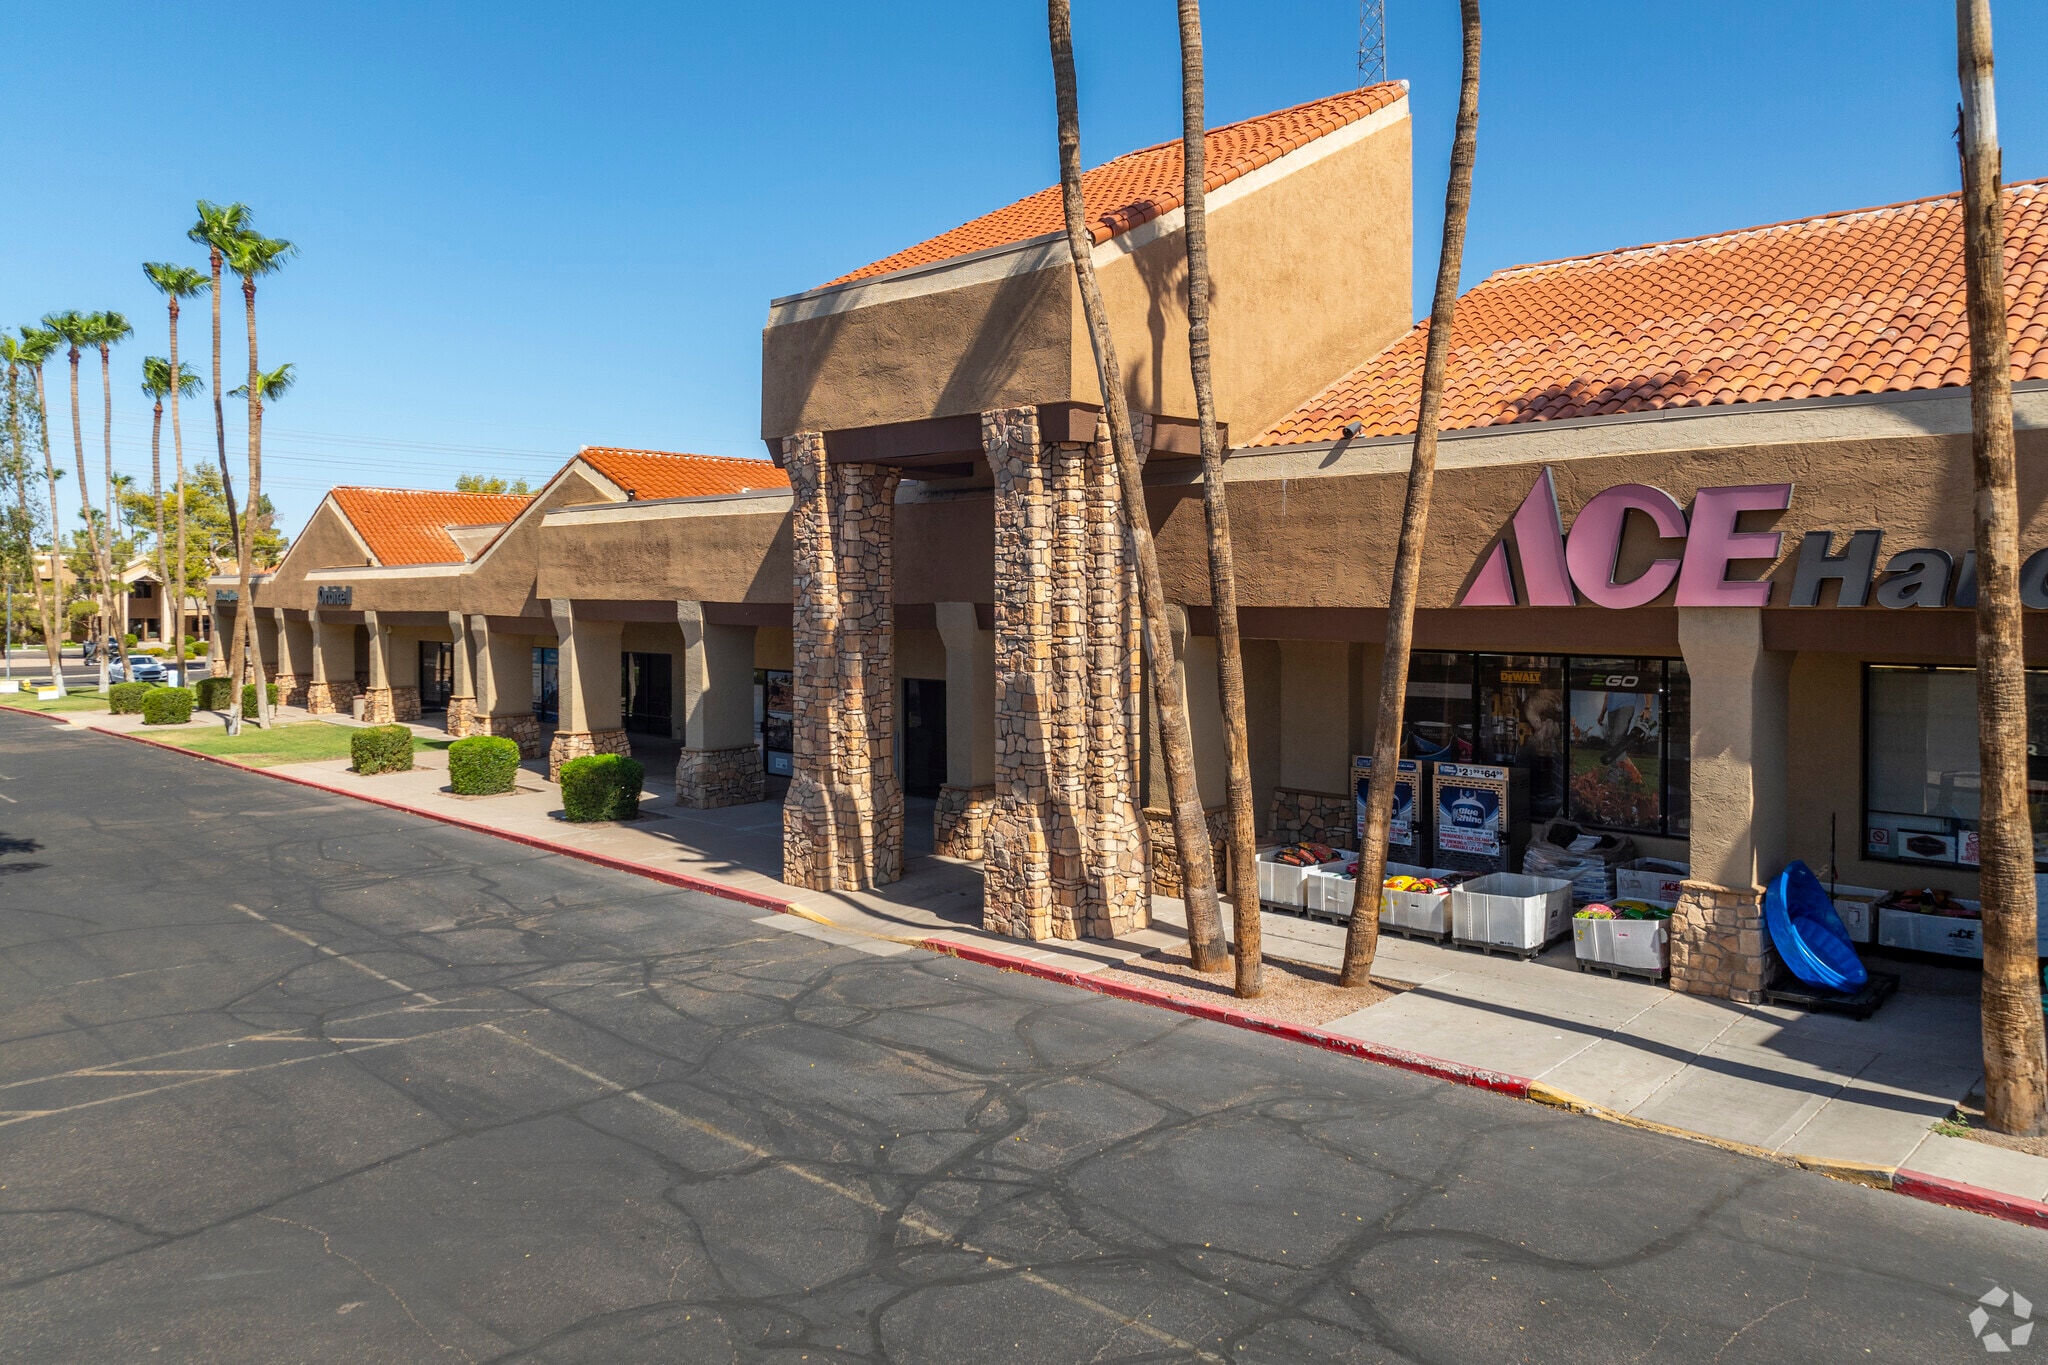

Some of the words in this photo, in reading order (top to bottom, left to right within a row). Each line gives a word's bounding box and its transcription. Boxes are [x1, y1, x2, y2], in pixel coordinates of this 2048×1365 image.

[1459, 466, 1796, 609] ACE
[1590, 674, 1639, 687] EGO
[1661, 881, 1681, 892] ACE
